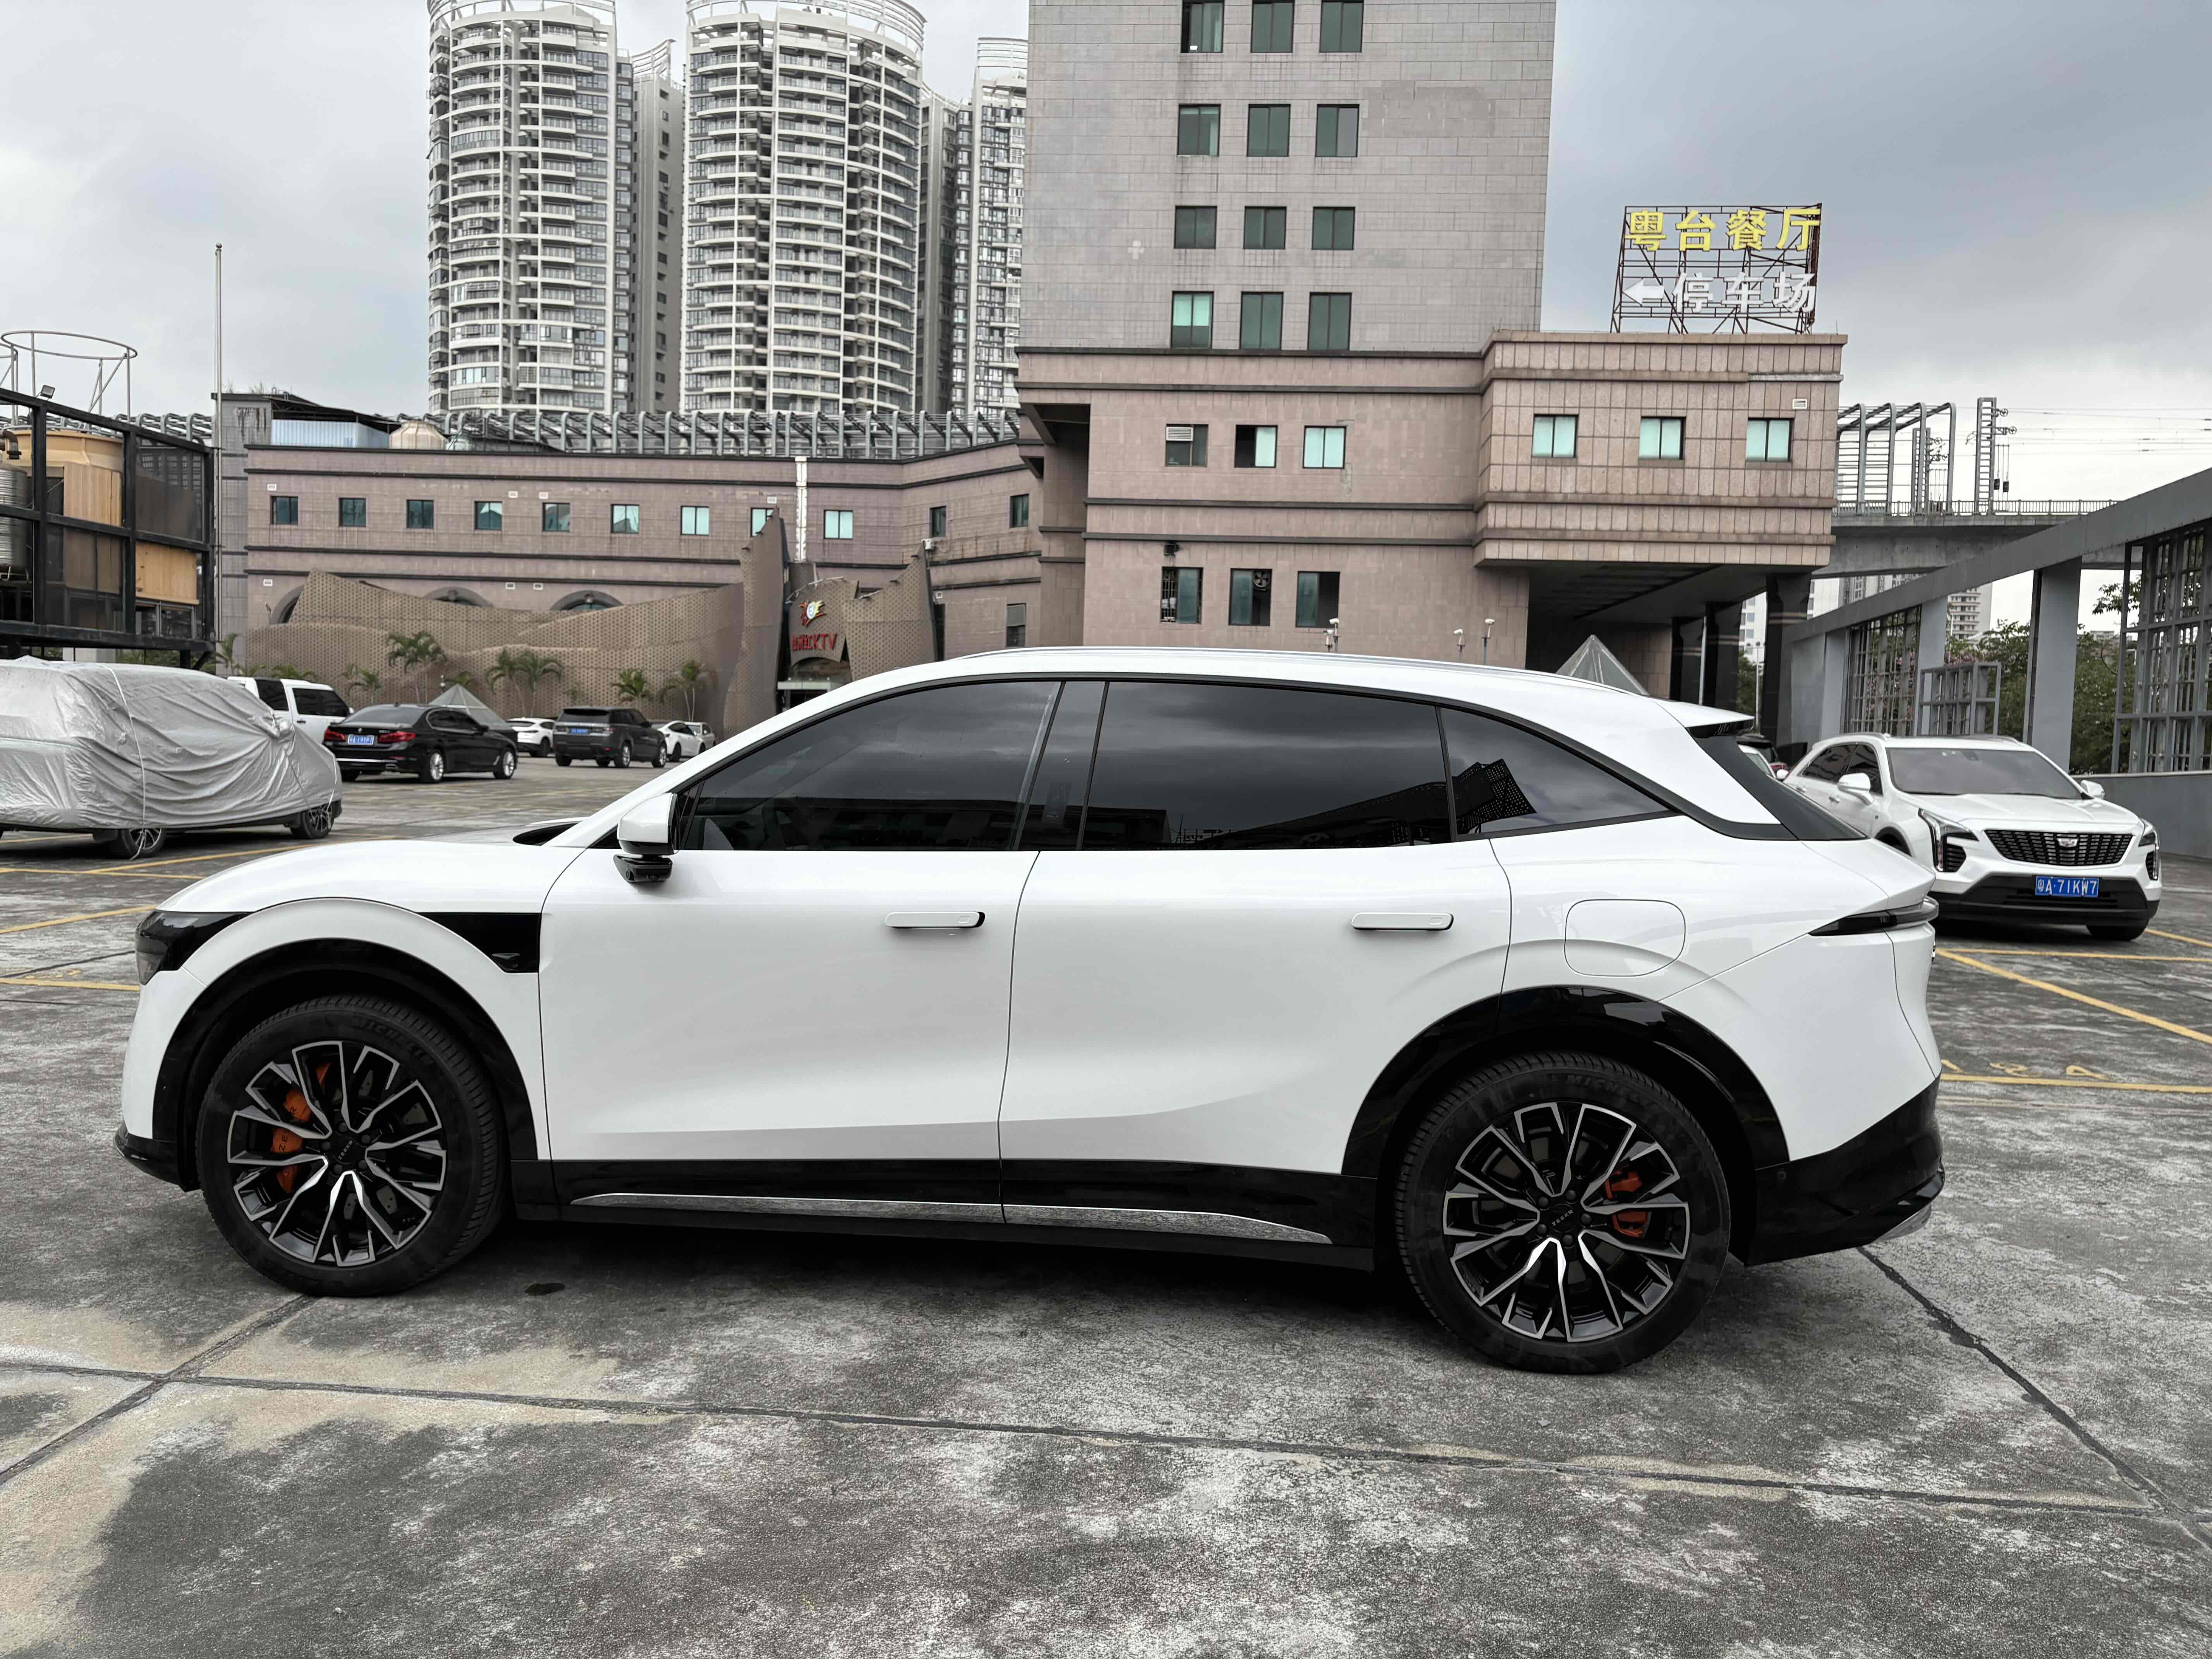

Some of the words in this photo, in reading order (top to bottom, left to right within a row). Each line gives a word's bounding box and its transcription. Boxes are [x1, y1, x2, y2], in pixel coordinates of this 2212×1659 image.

[1625, 209, 1821, 251] 粤台餐厅
[1672, 271, 1816, 313] 停车场
